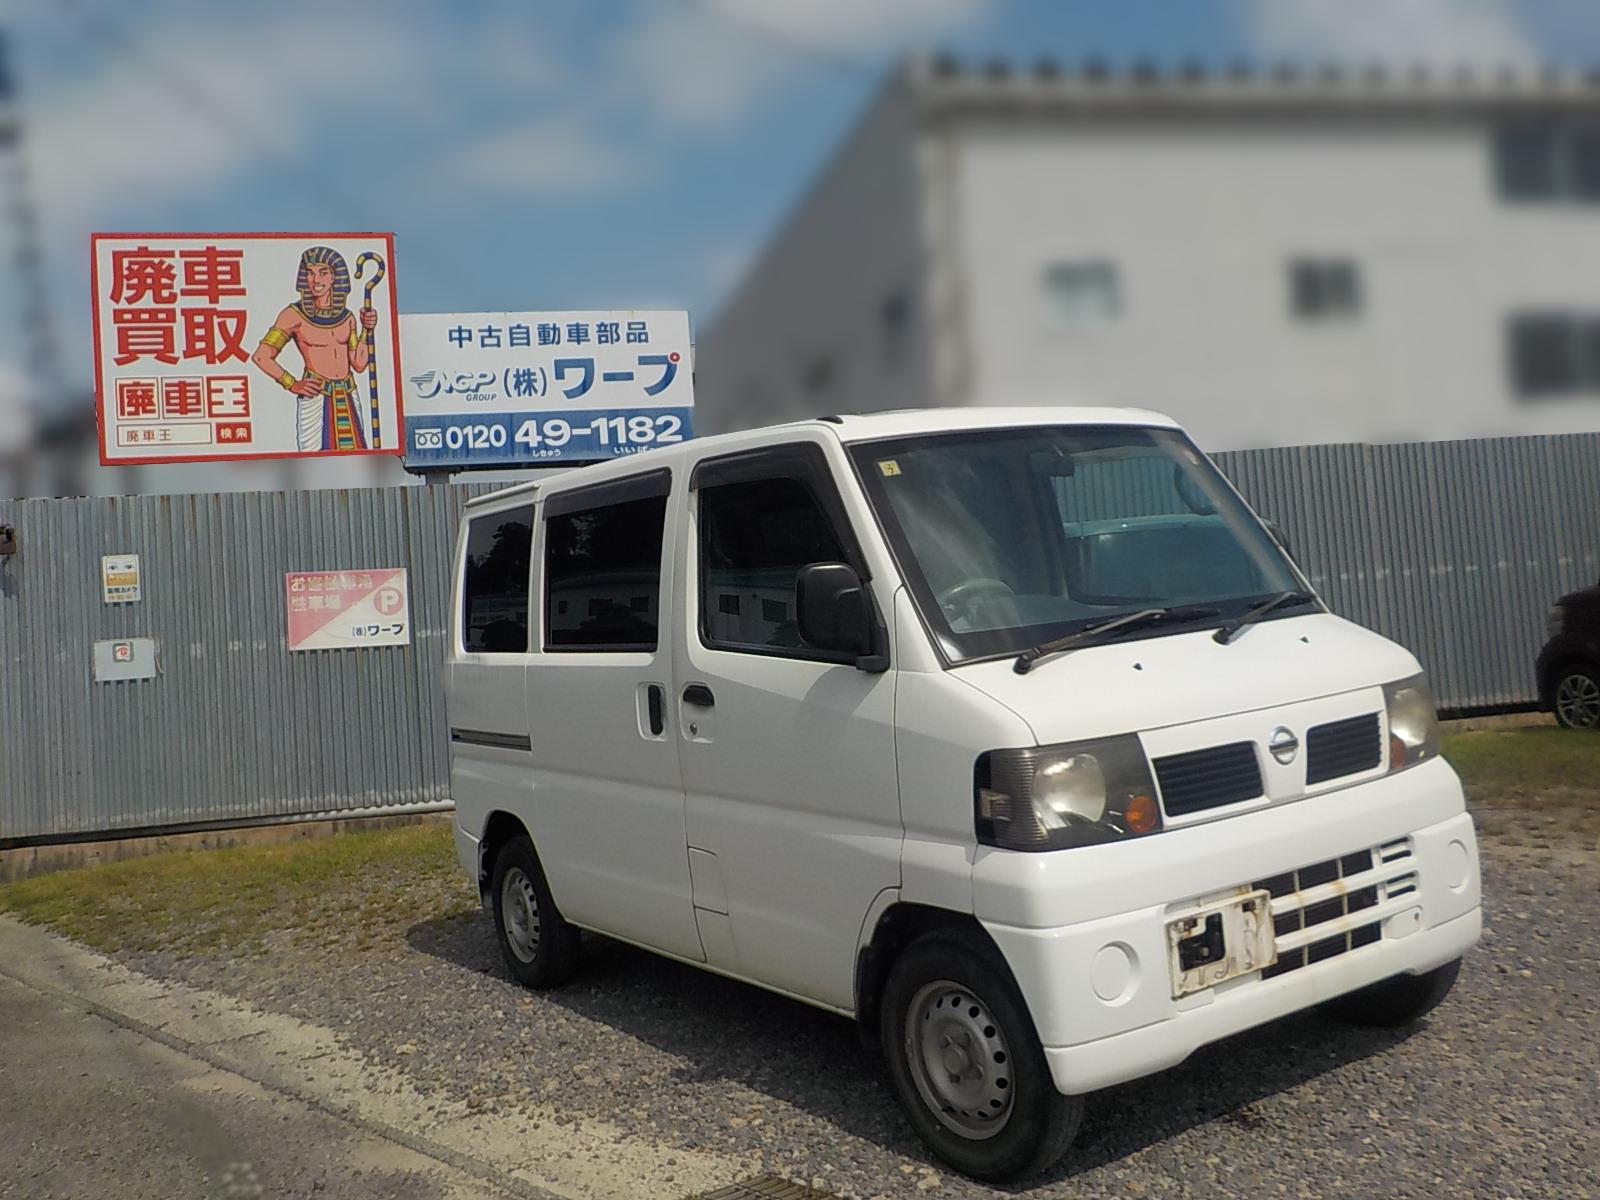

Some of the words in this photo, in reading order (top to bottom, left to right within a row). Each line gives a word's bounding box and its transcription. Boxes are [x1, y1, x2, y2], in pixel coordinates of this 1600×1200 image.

[109, 246, 247, 305] 廃車
[113, 307, 250, 366] 買取
[448, 321, 649, 349] 中古自動車部品
[466, 393, 497, 402] GROUP
[126, 428, 171, 442] 廃車王
[220, 426, 248, 440] 検索
[445, 424, 507, 449] 0120
[514, 415, 683, 447] 49-1182
[532, 448, 562, 457] しきゅう
[380, 591, 400, 612] P
